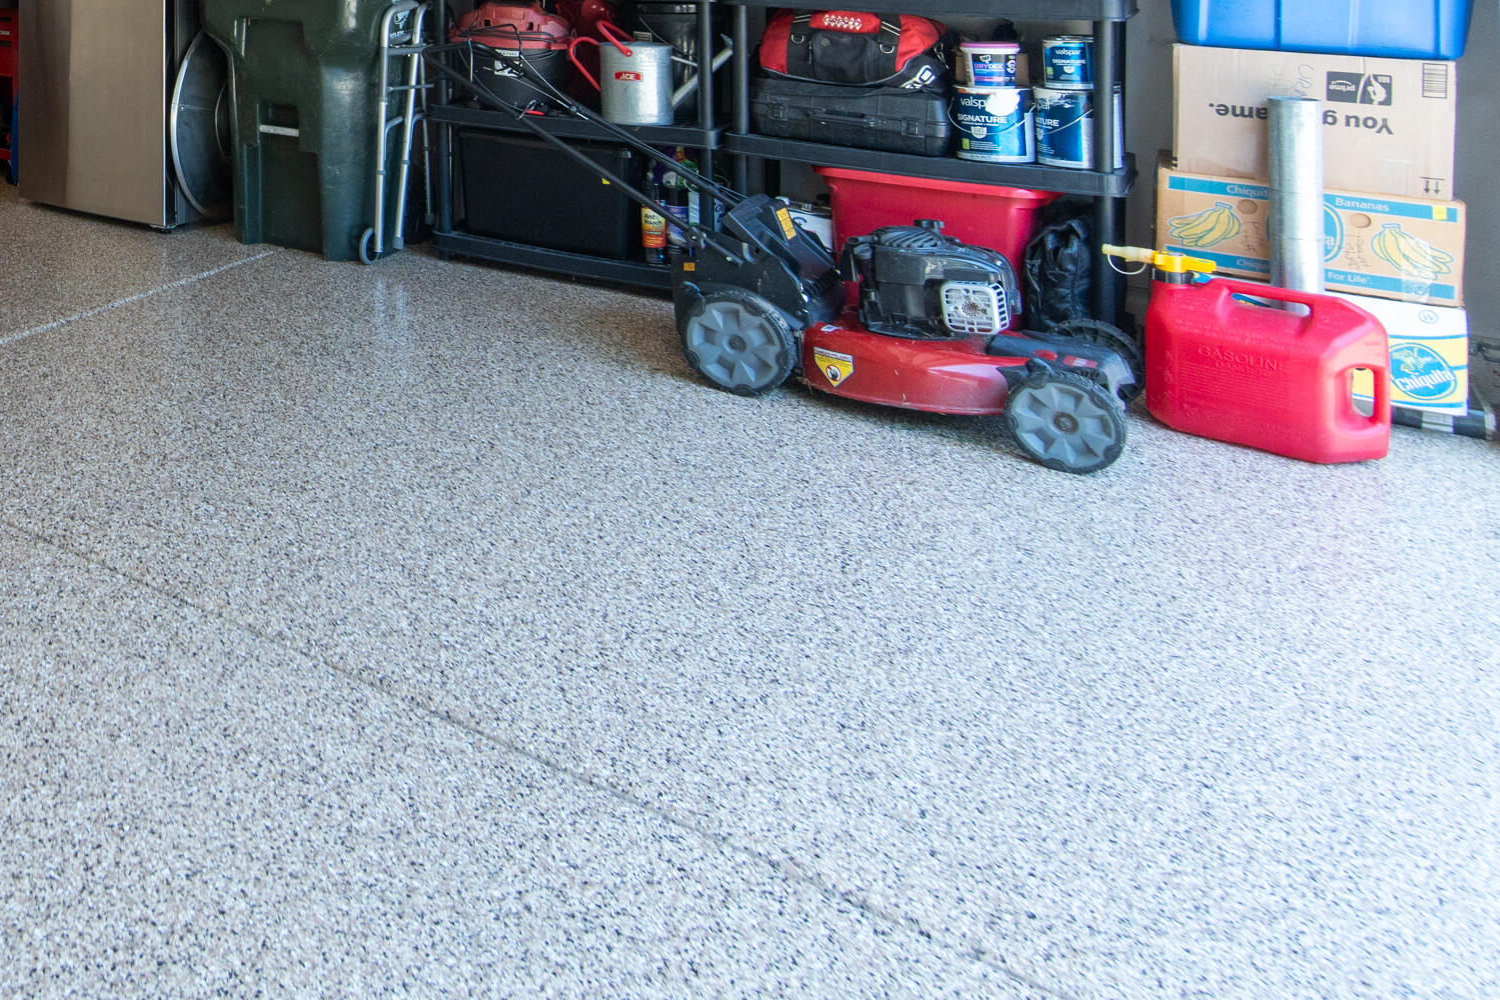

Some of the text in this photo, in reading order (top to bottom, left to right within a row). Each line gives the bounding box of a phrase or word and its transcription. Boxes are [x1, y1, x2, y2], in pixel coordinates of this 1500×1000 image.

[1329, 82, 1356, 93] prime
[960, 95, 990, 109] valsp
[957, 114, 1008, 124] SIGNATURE
[1344, 112, 1394, 135] You
[1226, 185, 1269, 198] Chiquit
[1334, 198, 1390, 212] Bananas
[1328, 271, 1345, 281] For
[1395, 369, 1456, 392] Chiquita
